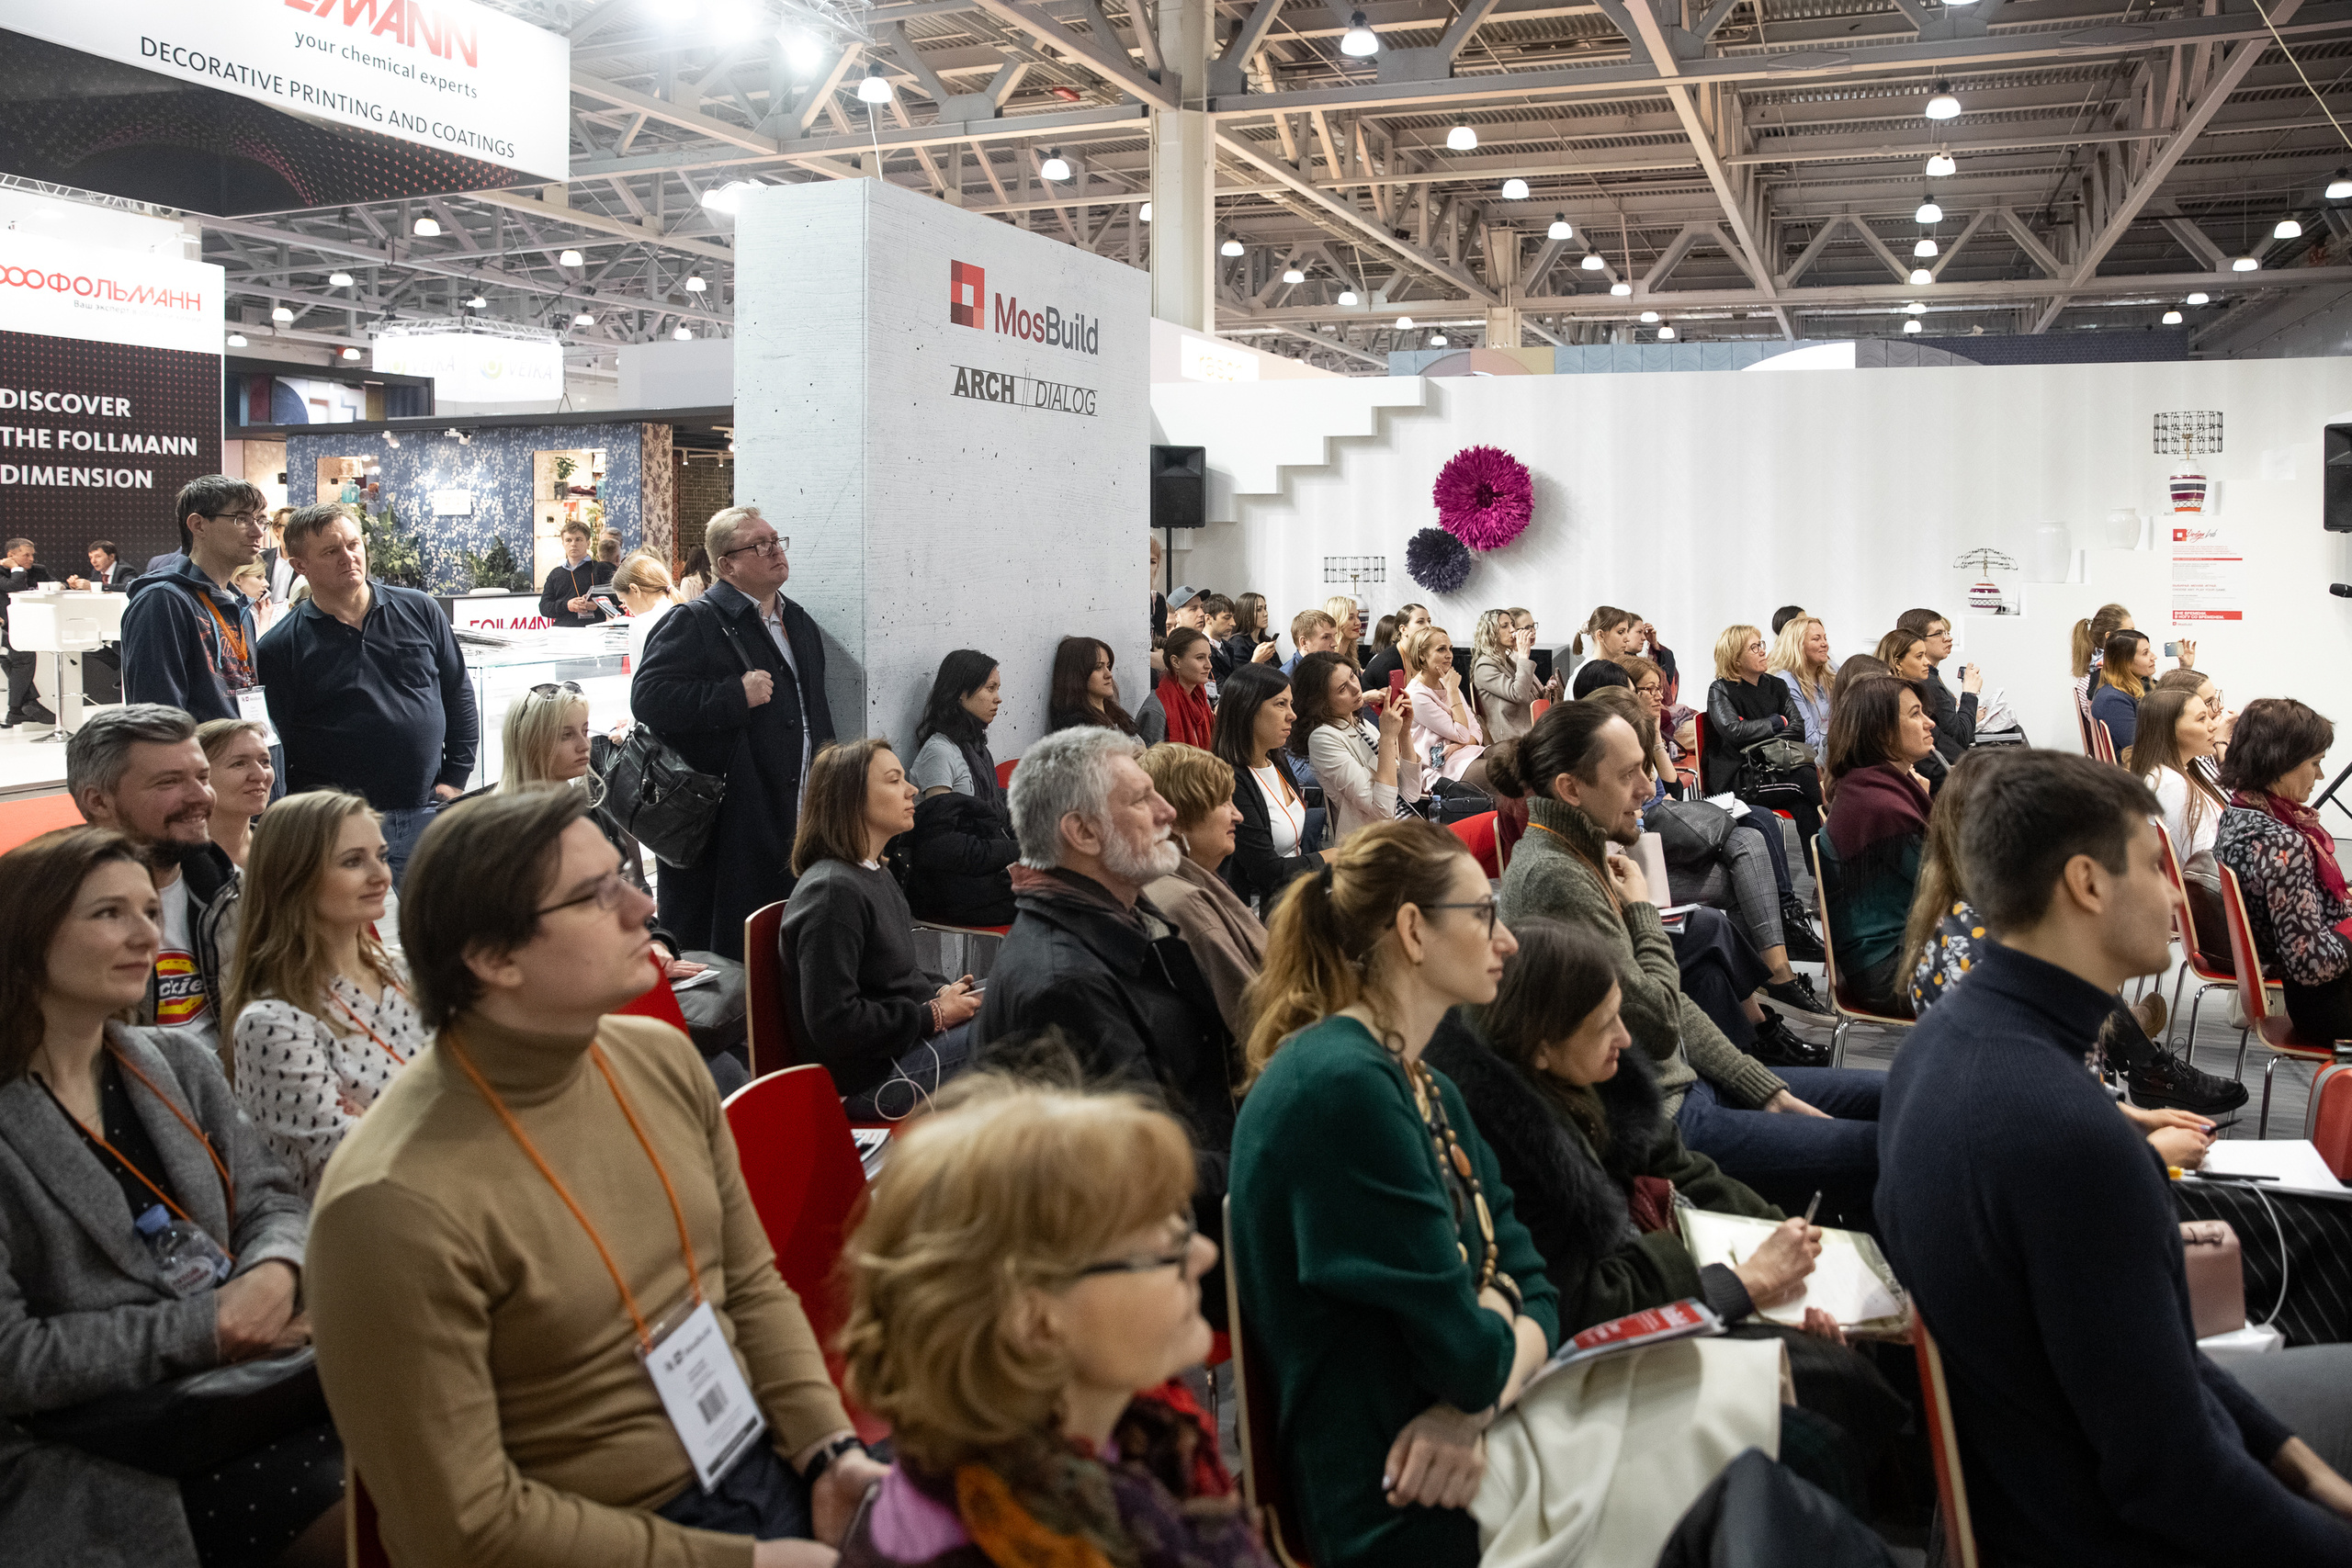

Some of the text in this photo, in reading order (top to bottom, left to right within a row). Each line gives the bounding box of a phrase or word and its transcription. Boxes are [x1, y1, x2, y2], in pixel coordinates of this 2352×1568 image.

[284, 0, 478, 69] MANN
[295, 31, 478, 98] your chemical experts
[141, 36, 514, 158] DECORATIVE PRINTING AND COATINGS
[74, 299, 93, 310] Ваш
[96, 304, 130, 315] эксперт
[995, 292, 1099, 355] MosBuild
[508, 359, 553, 380] VEIKA
[0, 388, 131, 417] DISCOVER
[954, 367, 1096, 415] ARCH DIALOG
[0, 426, 198, 456] THE FOLLMANN
[0, 464, 153, 489] DIMENSION
